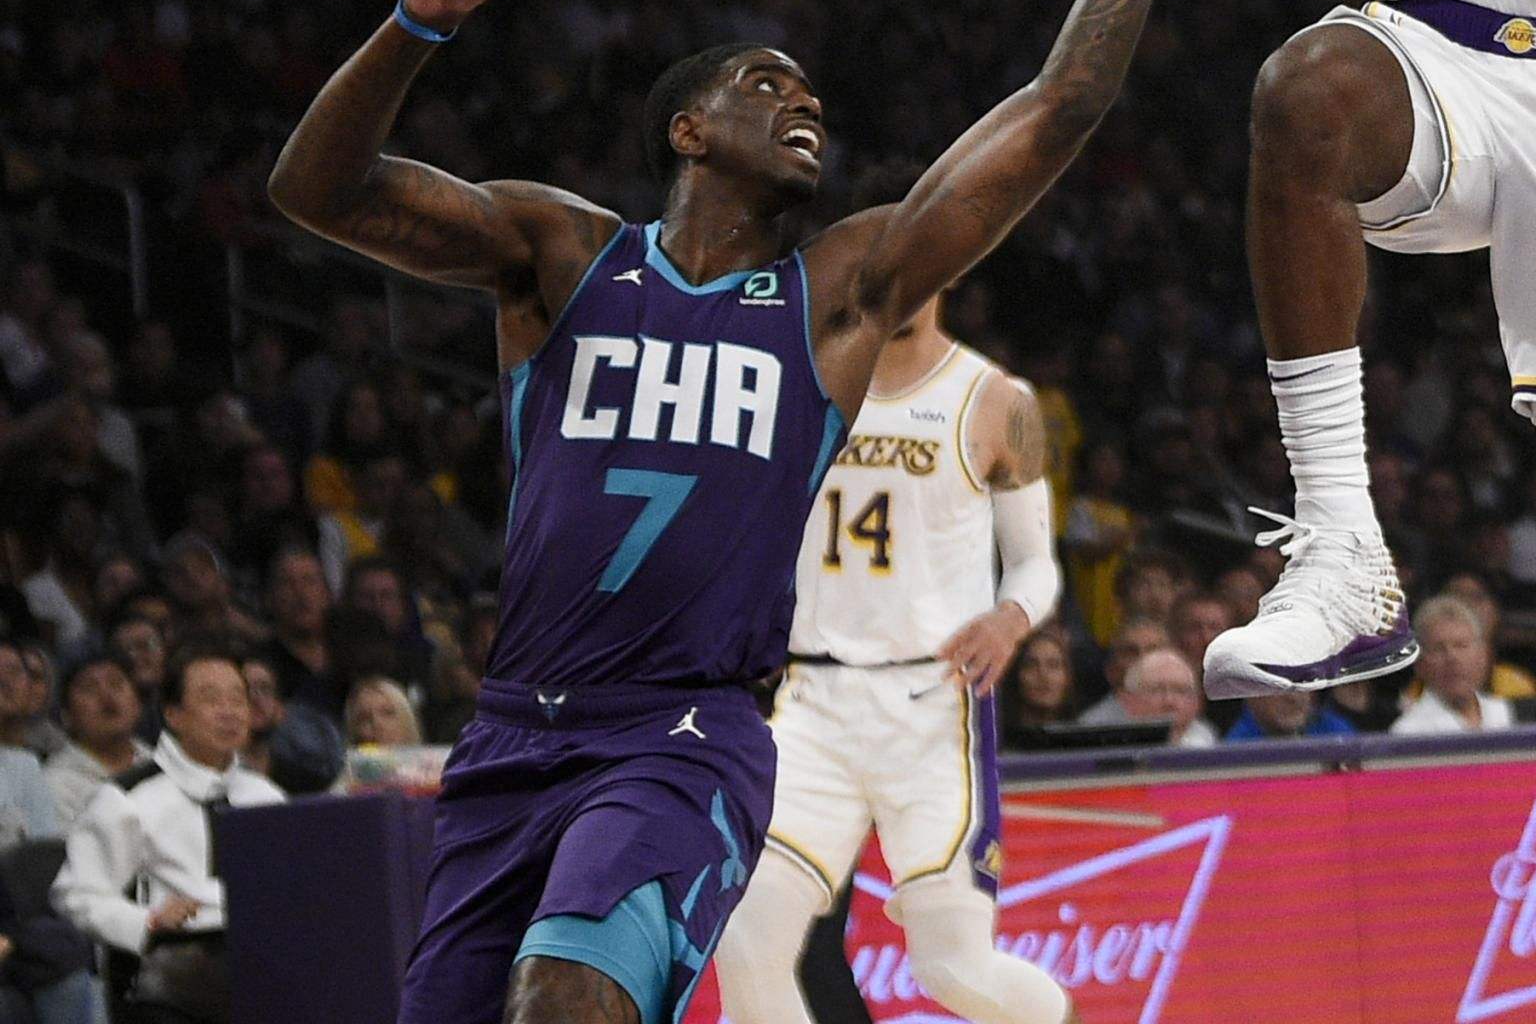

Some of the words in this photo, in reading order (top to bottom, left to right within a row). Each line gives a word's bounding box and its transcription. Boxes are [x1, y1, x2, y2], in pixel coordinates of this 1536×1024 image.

[560, 334, 782, 461] CHA
[838, 435, 939, 475] KERS
[598, 467, 699, 594] 7
[823, 488, 894, 576] 14
